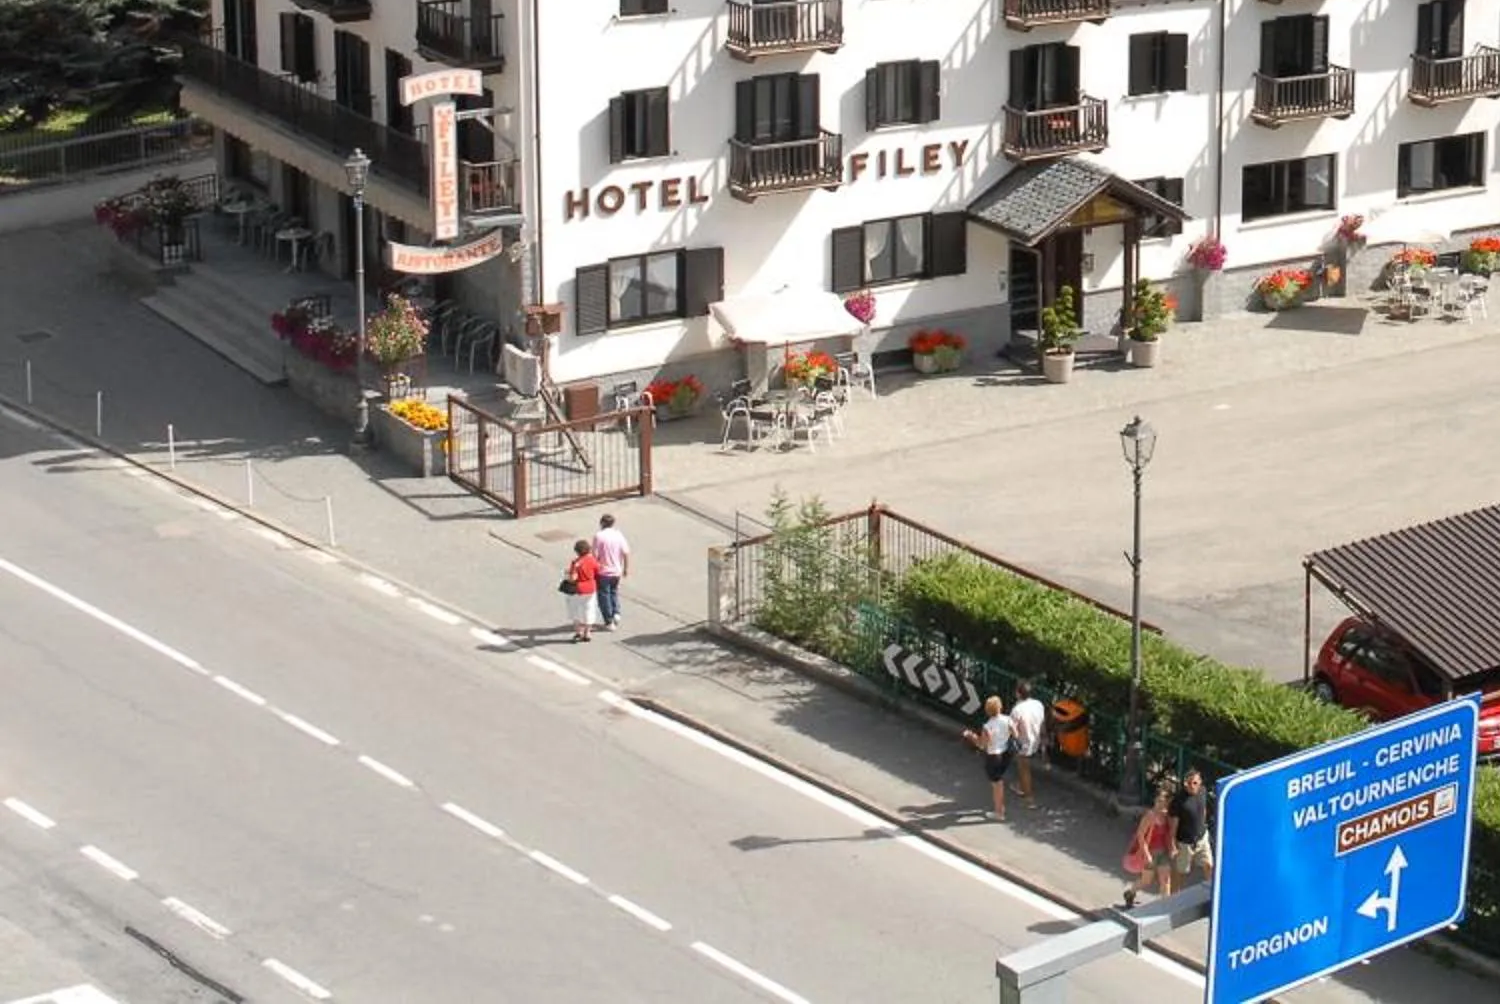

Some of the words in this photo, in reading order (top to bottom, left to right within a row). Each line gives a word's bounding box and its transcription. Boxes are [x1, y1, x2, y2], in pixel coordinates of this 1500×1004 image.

[411, 76, 477, 96] HOTEL
[438, 116, 454, 216] FILEY
[564, 175, 709, 219] HOTEL
[850, 139, 969, 182] FILEY
[397, 236, 501, 268] RISTORANTE
[1287, 760, 1357, 798] BREUIL
[1375, 723, 1462, 768] CERVINIA
[1293, 754, 1460, 829] VALTOURNENCHE
[1341, 799, 1429, 846] CHAMOIS
[1228, 916, 1329, 970] TORGNON
